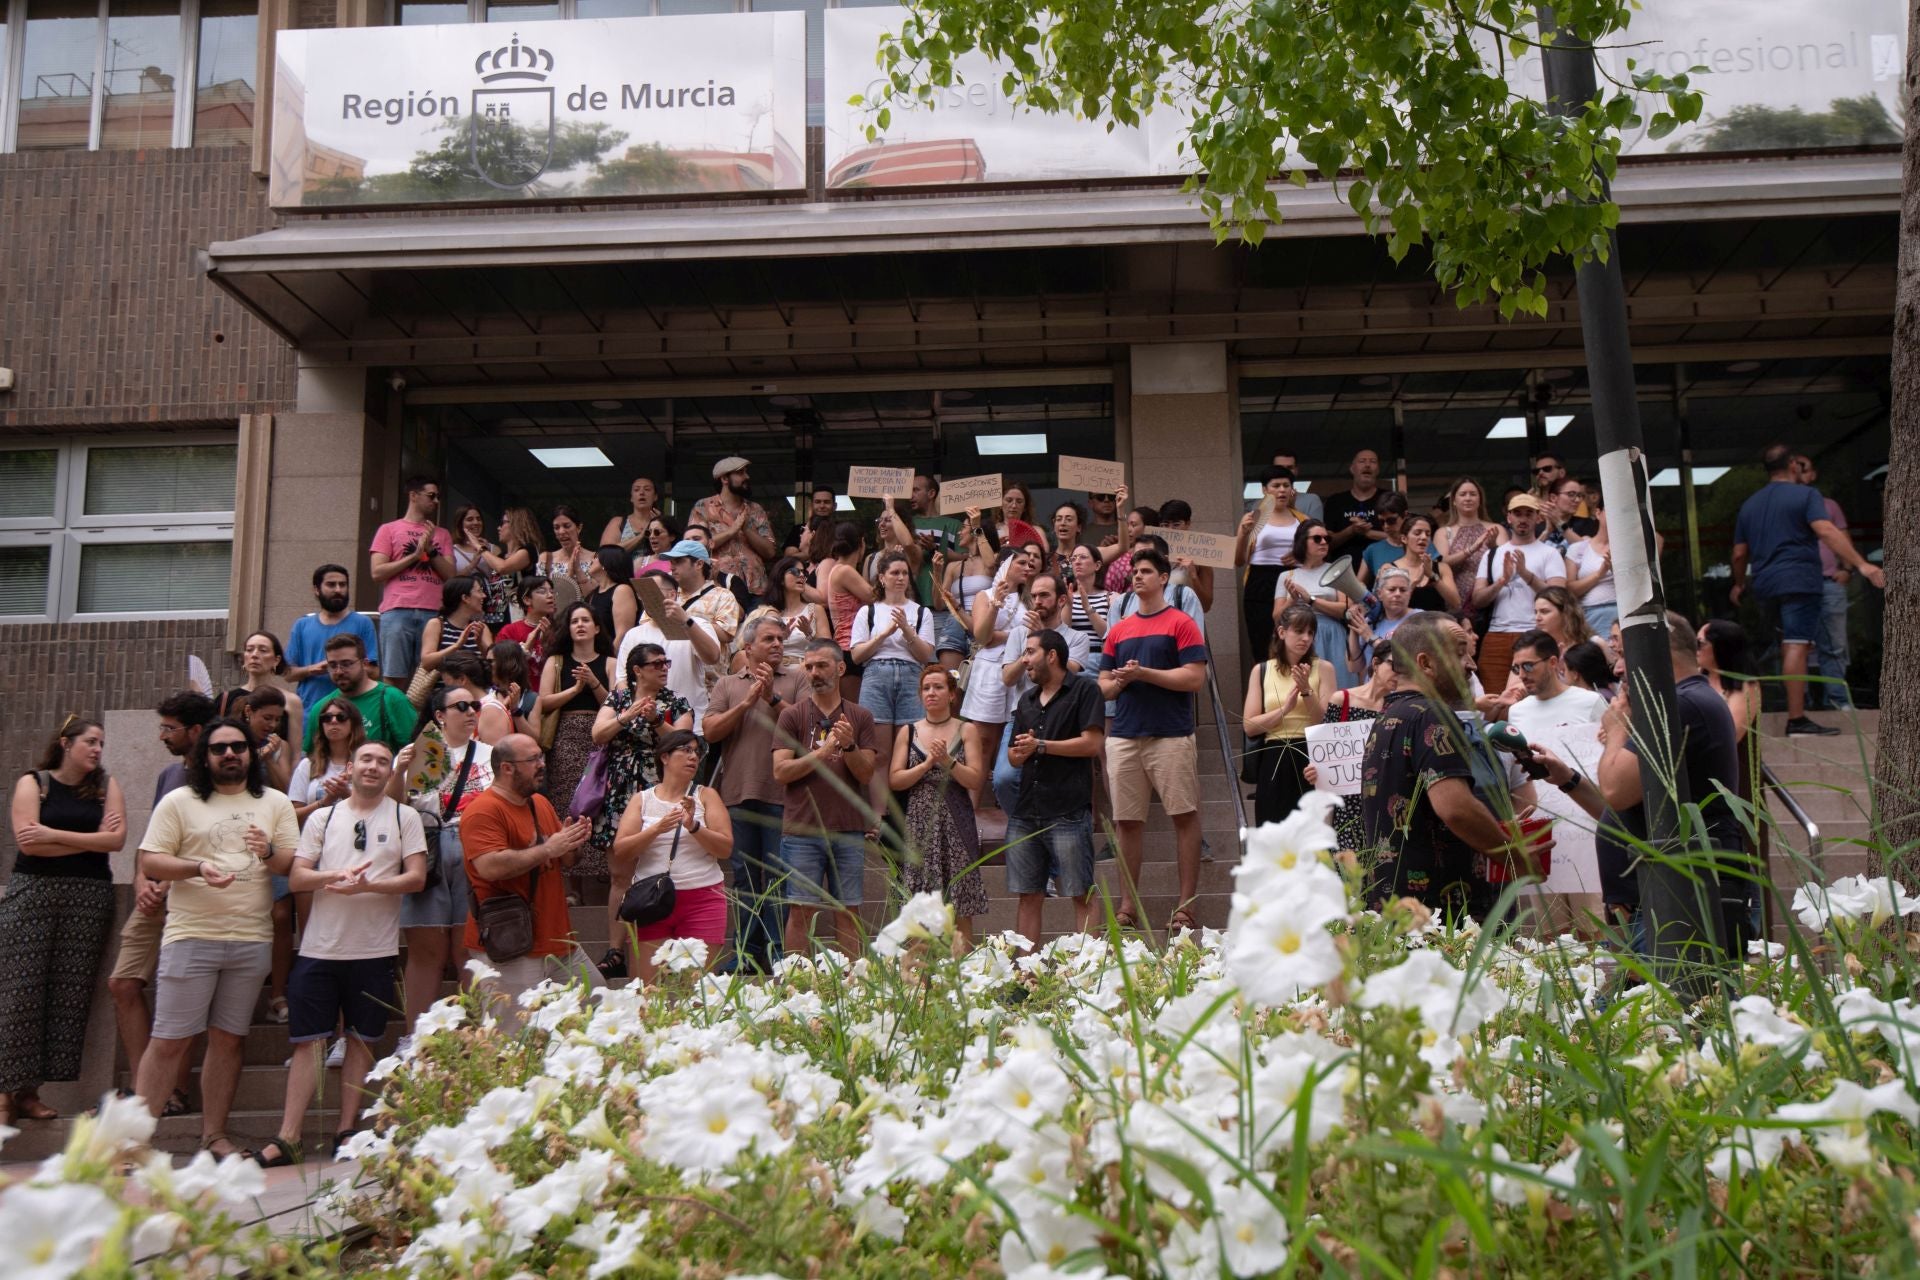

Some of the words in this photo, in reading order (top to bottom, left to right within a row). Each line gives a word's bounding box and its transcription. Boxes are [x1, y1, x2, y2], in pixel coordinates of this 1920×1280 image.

[342, 89, 460, 126] Región
[566, 84, 609, 112] de
[621, 79, 736, 110] Murcia
[1333, 725, 1352, 738] POR
[1360, 723, 1371, 735] UN
[1312, 738, 1366, 763] OPOSICI
[1328, 762, 1362, 786] JUS
